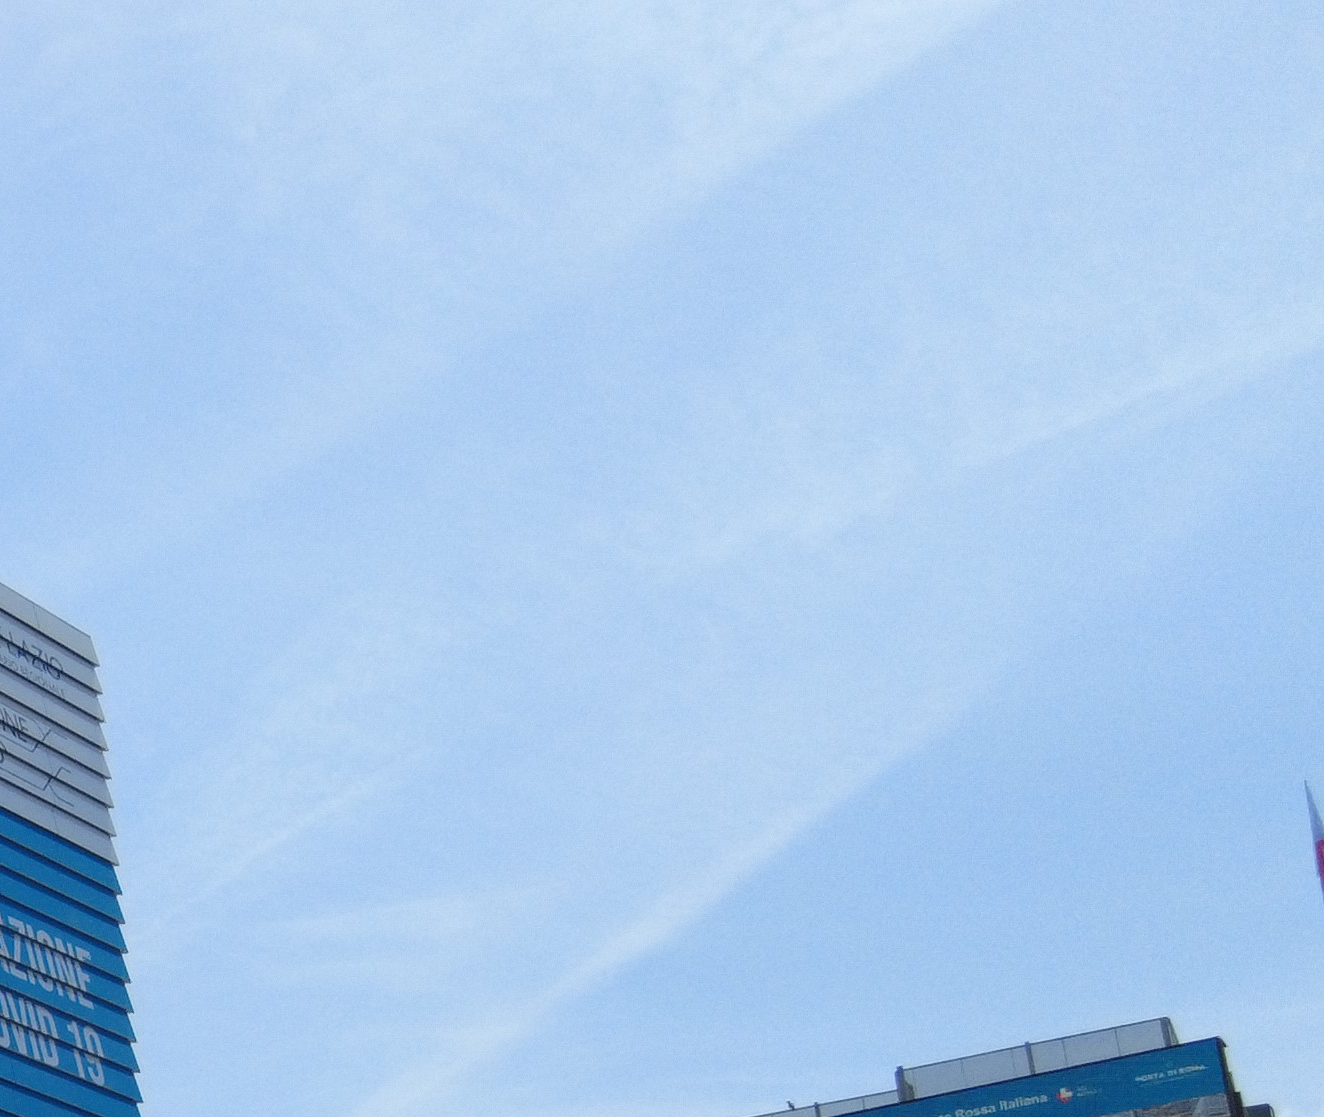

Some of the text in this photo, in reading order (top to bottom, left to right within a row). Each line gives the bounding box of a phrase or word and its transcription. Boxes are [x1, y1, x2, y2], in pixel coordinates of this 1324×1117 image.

[7, 632, 63, 680] LAZIO
[67, 1019, 105, 1086] 19
[999, 1095, 1048, 1112] Italiana
